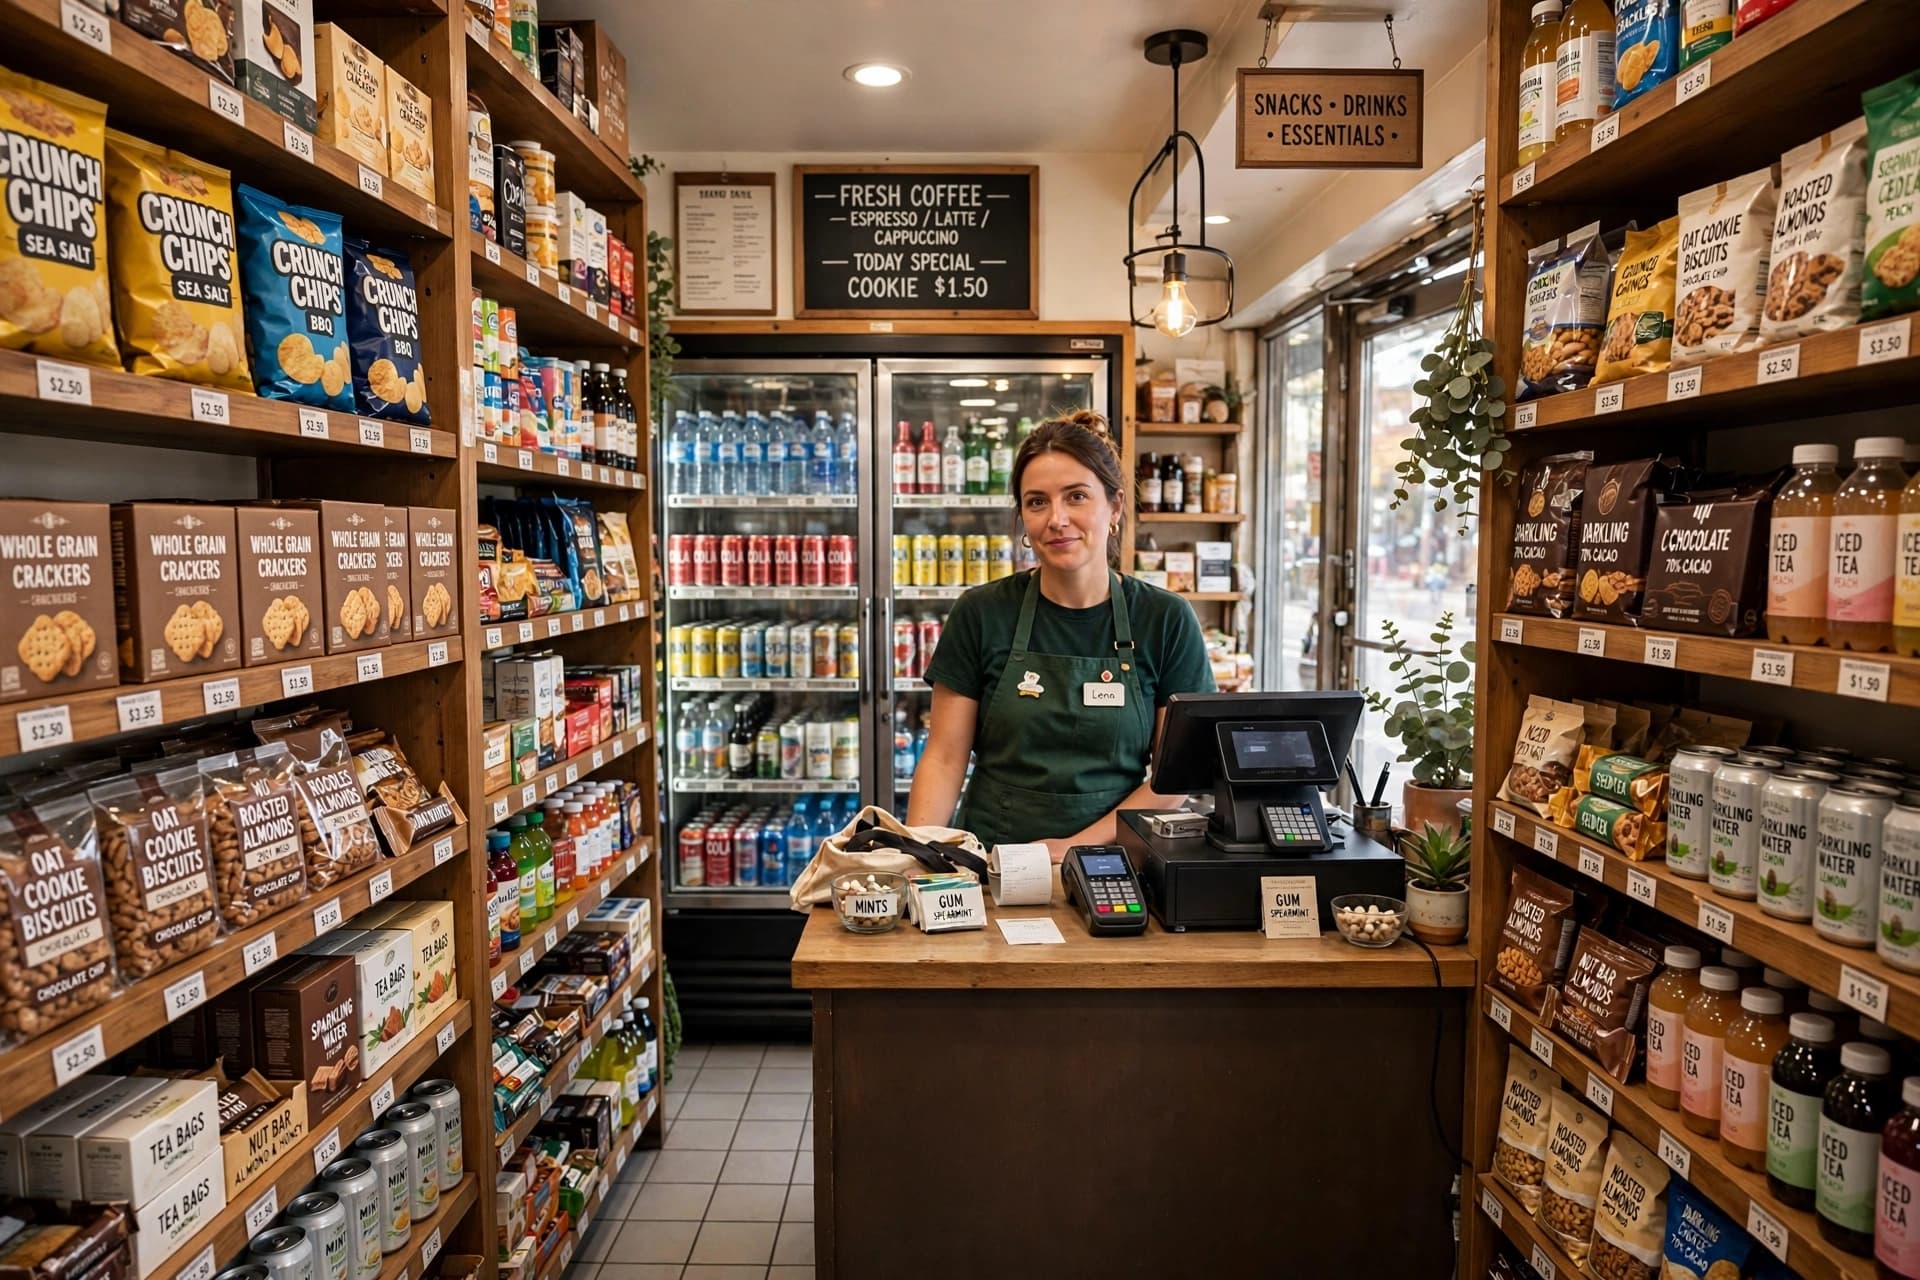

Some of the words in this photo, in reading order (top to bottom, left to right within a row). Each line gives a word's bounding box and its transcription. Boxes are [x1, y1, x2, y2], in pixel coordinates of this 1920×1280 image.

[72, 14, 104, 43] $2.50
[1254, 93, 1322, 116] SNACKS
[1344, 94, 1407, 117] DRINKS
[1281, 124, 1385, 146] ESSENTIALS
[840, 185, 900, 207] FRESH
[910, 184, 982, 206] COFFEE
[8, 178, 97, 240] CHIPS
[140, 192, 234, 249] CRUNCH
[850, 211, 917, 227] ESPRESSO
[934, 211, 976, 227] LATTE
[1775, 201, 1827, 238] ALMONDS
[874, 230, 959, 246] CAPPUCCINO
[1682, 228, 1700, 253] OAT
[1700, 213, 1743, 245] COOKIE
[25, 233, 57, 258] SEA
[59, 240, 92, 265] SALT
[163, 234, 232, 281] CHIPS
[1684, 242, 1729, 273] BISCUITS
[273, 241, 344, 286] CRUNCH
[853, 253, 902, 272] TODAY
[910, 253, 974, 272] SPECIAL
[178, 280, 201, 298] SEA
[204, 285, 229, 304] SALT
[291, 275, 343, 315] CHIPS
[363, 275, 418, 315] CRUNCH
[847, 277, 919, 298] COOKIE
[934, 276, 988, 298] $1.50
[310, 315, 334, 336] BBQ
[378, 306, 418, 340] CHIPS
[394, 340, 413, 358] BBQ
[1870, 335, 1901, 355] $3.50
[1766, 358, 1792, 376] $2.50
[50, 377, 82, 396] $2.50
[200, 401, 224, 418] $2.50
[0, 535, 53, 559] WHOLE
[56, 535, 98, 557] GRAIN
[151, 535, 193, 556] WHOLE
[194, 535, 226, 555] GRAIN
[250, 535, 284, 554] WHOLE
[285, 535, 312, 553] GRAIN
[331, 530, 358, 547] WHOLE
[359, 531, 380, 547] GRAIN
[415, 531, 436, 547] WHOLE
[1773, 533, 1797, 552] ICED
[1835, 533, 1863, 552] ICED
[258, 558, 308, 577] CRACKERS
[338, 552, 377, 570] CRACKERS
[828, 550, 852, 564] COLA
[1592, 548, 1618, 563] CACAO
[1665, 559, 1681, 573] 70%
[1682, 559, 1712, 575] CACAO
[1774, 555, 1794, 573] TEA
[1836, 555, 1858, 575] TEA
[13, 563, 92, 589] CRACKERS
[160, 560, 221, 582] CRACKERS
[1761, 661, 1785, 678] $3.50
[1850, 674, 1880, 692] $1.50
[212, 690, 235, 705] $2.50
[31, 722, 63, 741] $2.50
[151, 806, 179, 832] OAT
[238, 795, 289, 828] ROASTED
[242, 814, 294, 850] ALMONDS
[1712, 818, 1739, 837] WATER
[145, 826, 198, 861] COOKIE
[706, 841, 730, 855] COLA
[1761, 834, 1792, 855] WATER
[31, 846, 65, 876] OAT
[142, 849, 204, 889] BISCUITS
[1761, 852, 1785, 867] LEMON
[1819, 852, 1855, 876] WATER
[24, 867, 88, 910] COOKIE
[1819, 871, 1847, 888] LEMON
[855, 899, 888, 914] MINTS
[939, 893, 964, 908] GUM
[1276, 893, 1300, 907] GUM
[21, 892, 97, 942] BISCUITS
[1506, 912, 1543, 943] ALMONDS
[422, 947, 433, 965] TEA
[432, 933, 448, 957] BAGS
[1578, 951, 1597, 972] NUT
[1597, 960, 1617, 986] BAR
[374, 979, 389, 999] TEA
[388, 963, 406, 987] BAGS
[1570, 971, 1614, 1006] ALMONDS
[311, 998, 353, 1041] SPARKLING
[322, 1021, 348, 1050] WATER
[1649, 1034, 1663, 1053] TEA
[66, 1043, 97, 1072] $2.50
[1683, 1057, 1698, 1078] TEA
[1725, 1065, 1745, 1089] ICED
[1725, 1083, 1742, 1108] TEA
[1504, 1096, 1537, 1127] ALMONDS
[1771, 1096, 1794, 1122] ICED
[150, 1136, 172, 1165] TEA
[176, 1112, 205, 1148] BAGS
[249, 1126, 269, 1156] NUT
[272, 1109, 291, 1138] BAR
[1771, 1118, 1791, 1142] TEA
[1550, 1138, 1582, 1173] ALMONDS
[1822, 1131, 1848, 1161] ICED
[1823, 1155, 1845, 1182] TEA
[1602, 1180, 1641, 1222] ALMONDS
[1882, 1174, 1911, 1205] ICED
[157, 1203, 179, 1234] TEA
[183, 1178, 210, 1213] BAGS
[1883, 1197, 1908, 1228] TEA
[325, 1231, 347, 1256] MINT
[1755, 1219, 1781, 1249] $1.99
